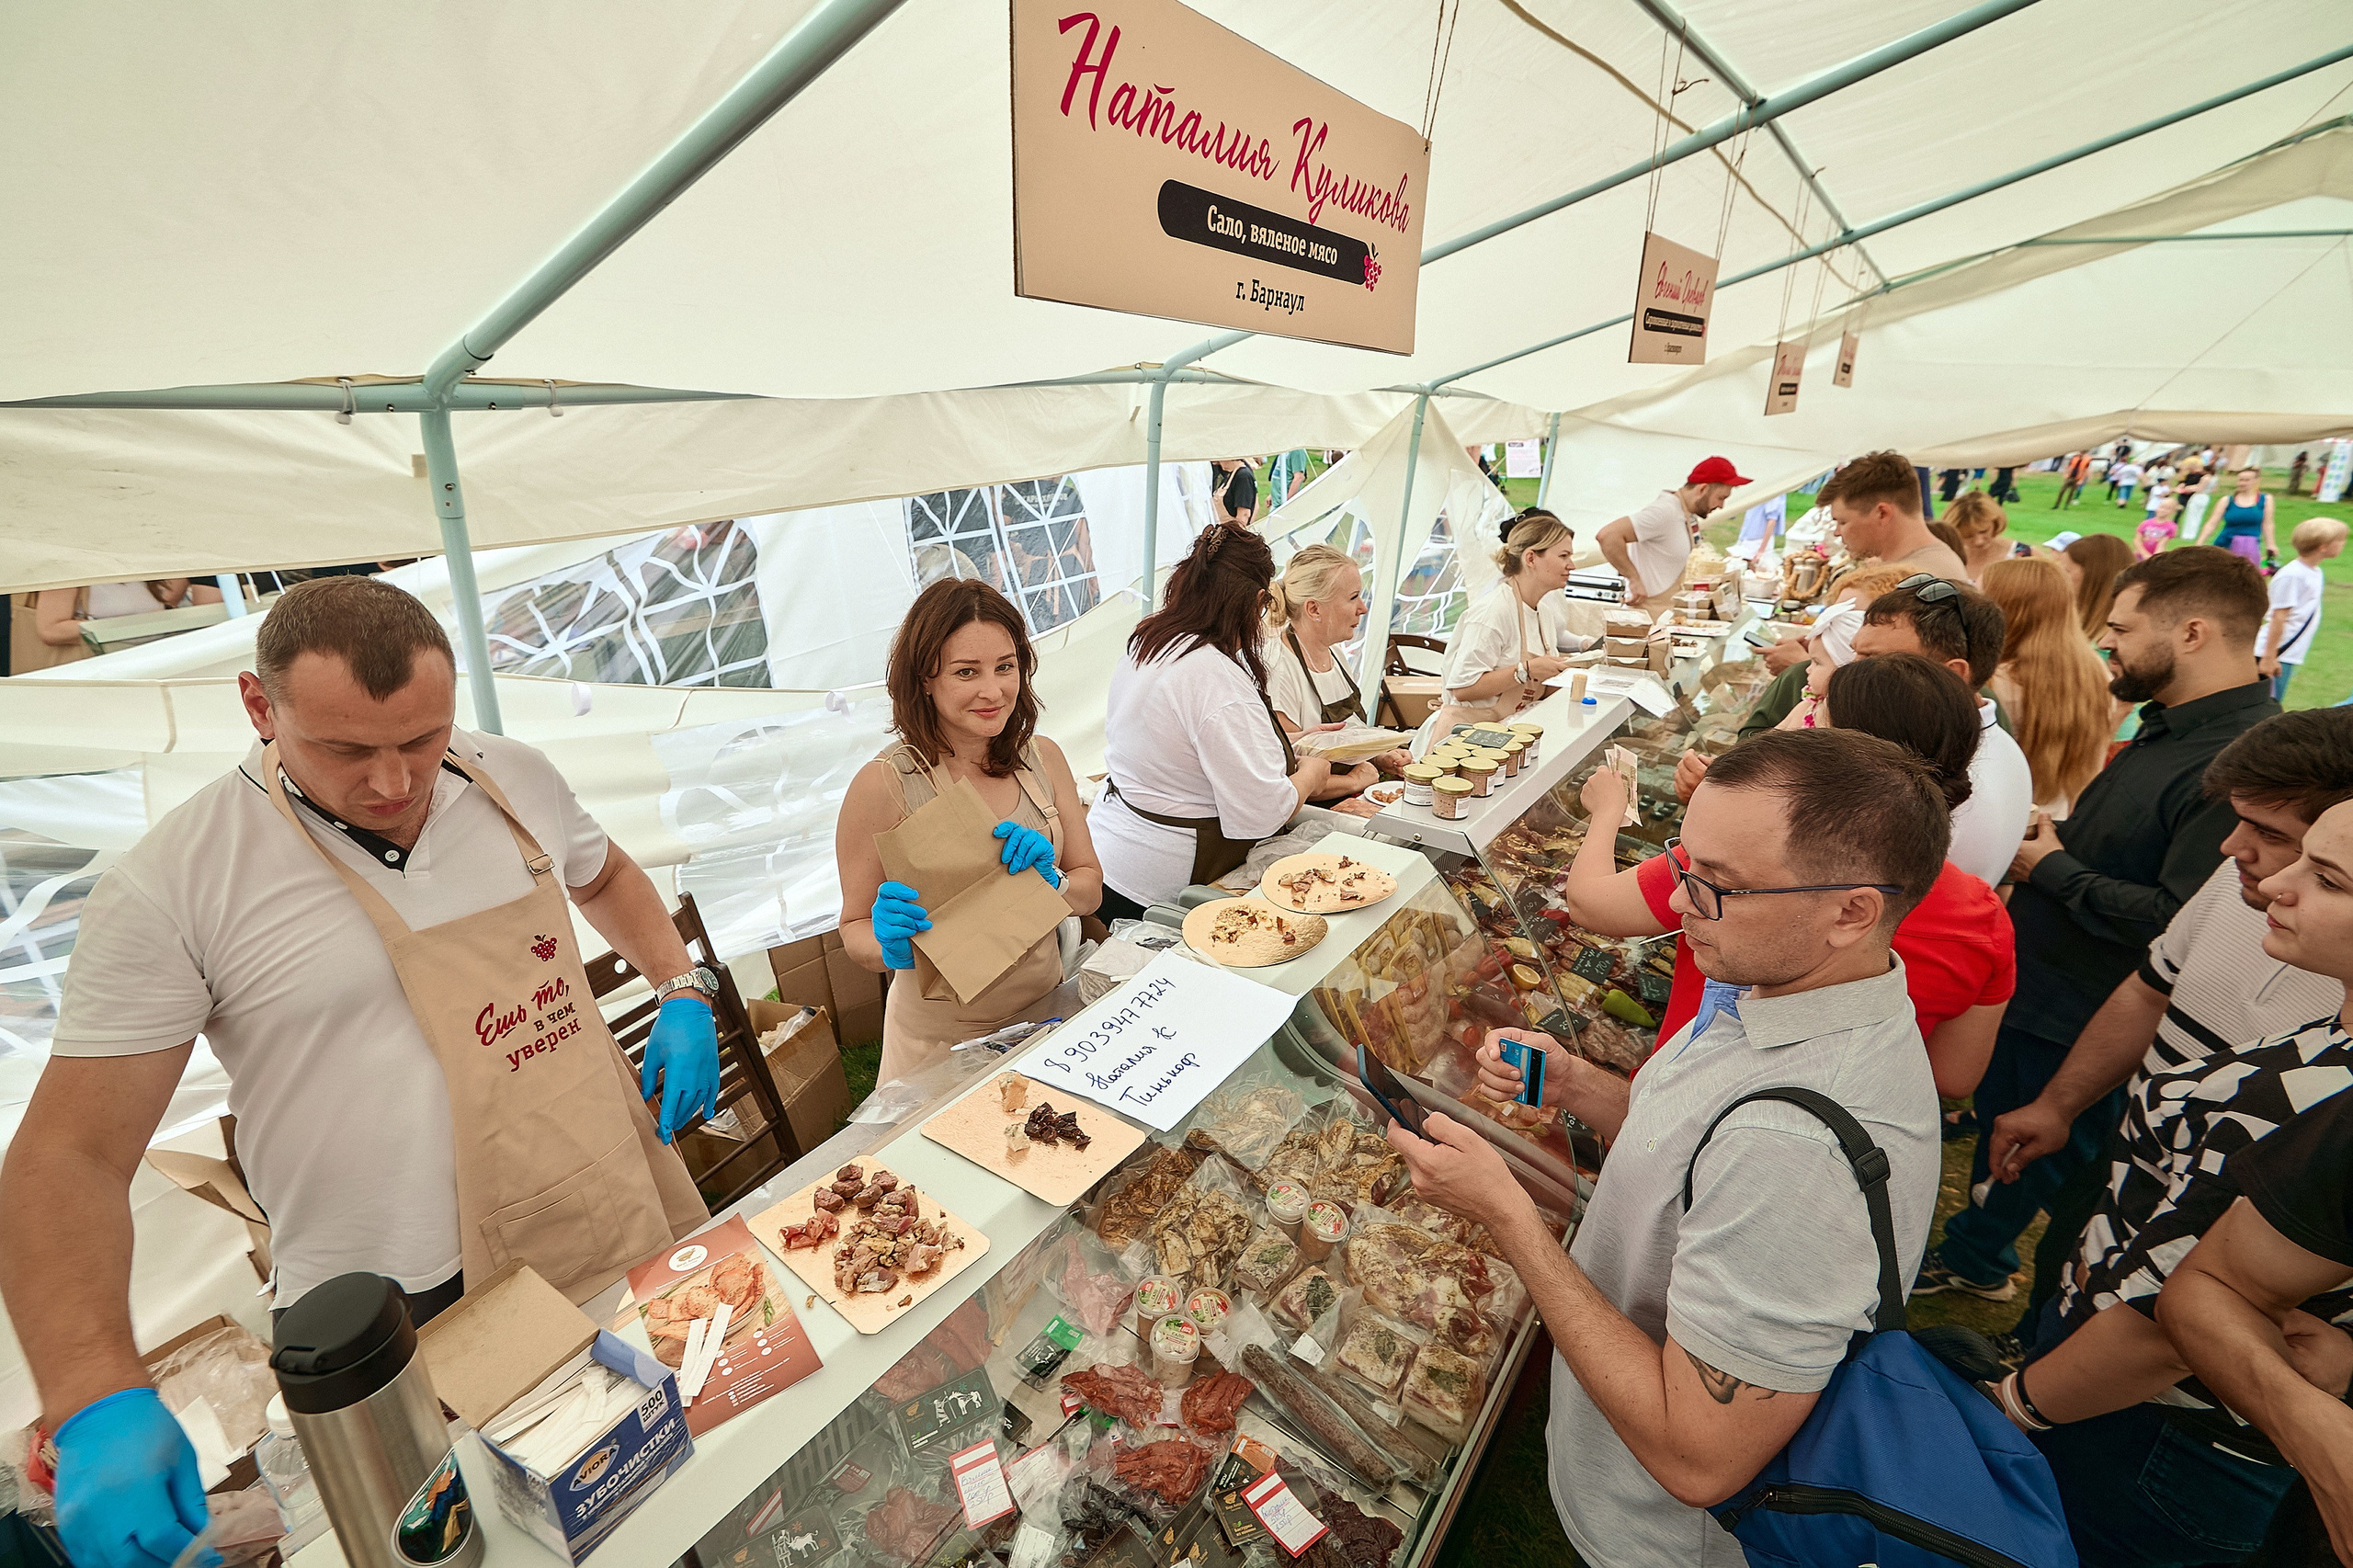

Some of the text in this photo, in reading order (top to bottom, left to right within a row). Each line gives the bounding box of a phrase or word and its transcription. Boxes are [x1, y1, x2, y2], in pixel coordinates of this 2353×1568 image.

[1058, 12, 1410, 233] Наталия Куликова
[1207, 204, 1338, 266] Сало, вяленое мясо
[1235, 278, 1305, 315] г. Барнаул
[475, 976, 570, 1047] Ешь то,
[533, 1002, 576, 1032] в чем
[506, 1017, 582, 1072] уверен
[1086, 1044, 1157, 1090] Наталия
[641, 1390, 664, 1416] 500
[642, 1400, 665, 1423] ШТУК
[573, 1448, 618, 1489] AVIORA
[574, 1417, 676, 1518] ЗУБОЧИСТКИ
